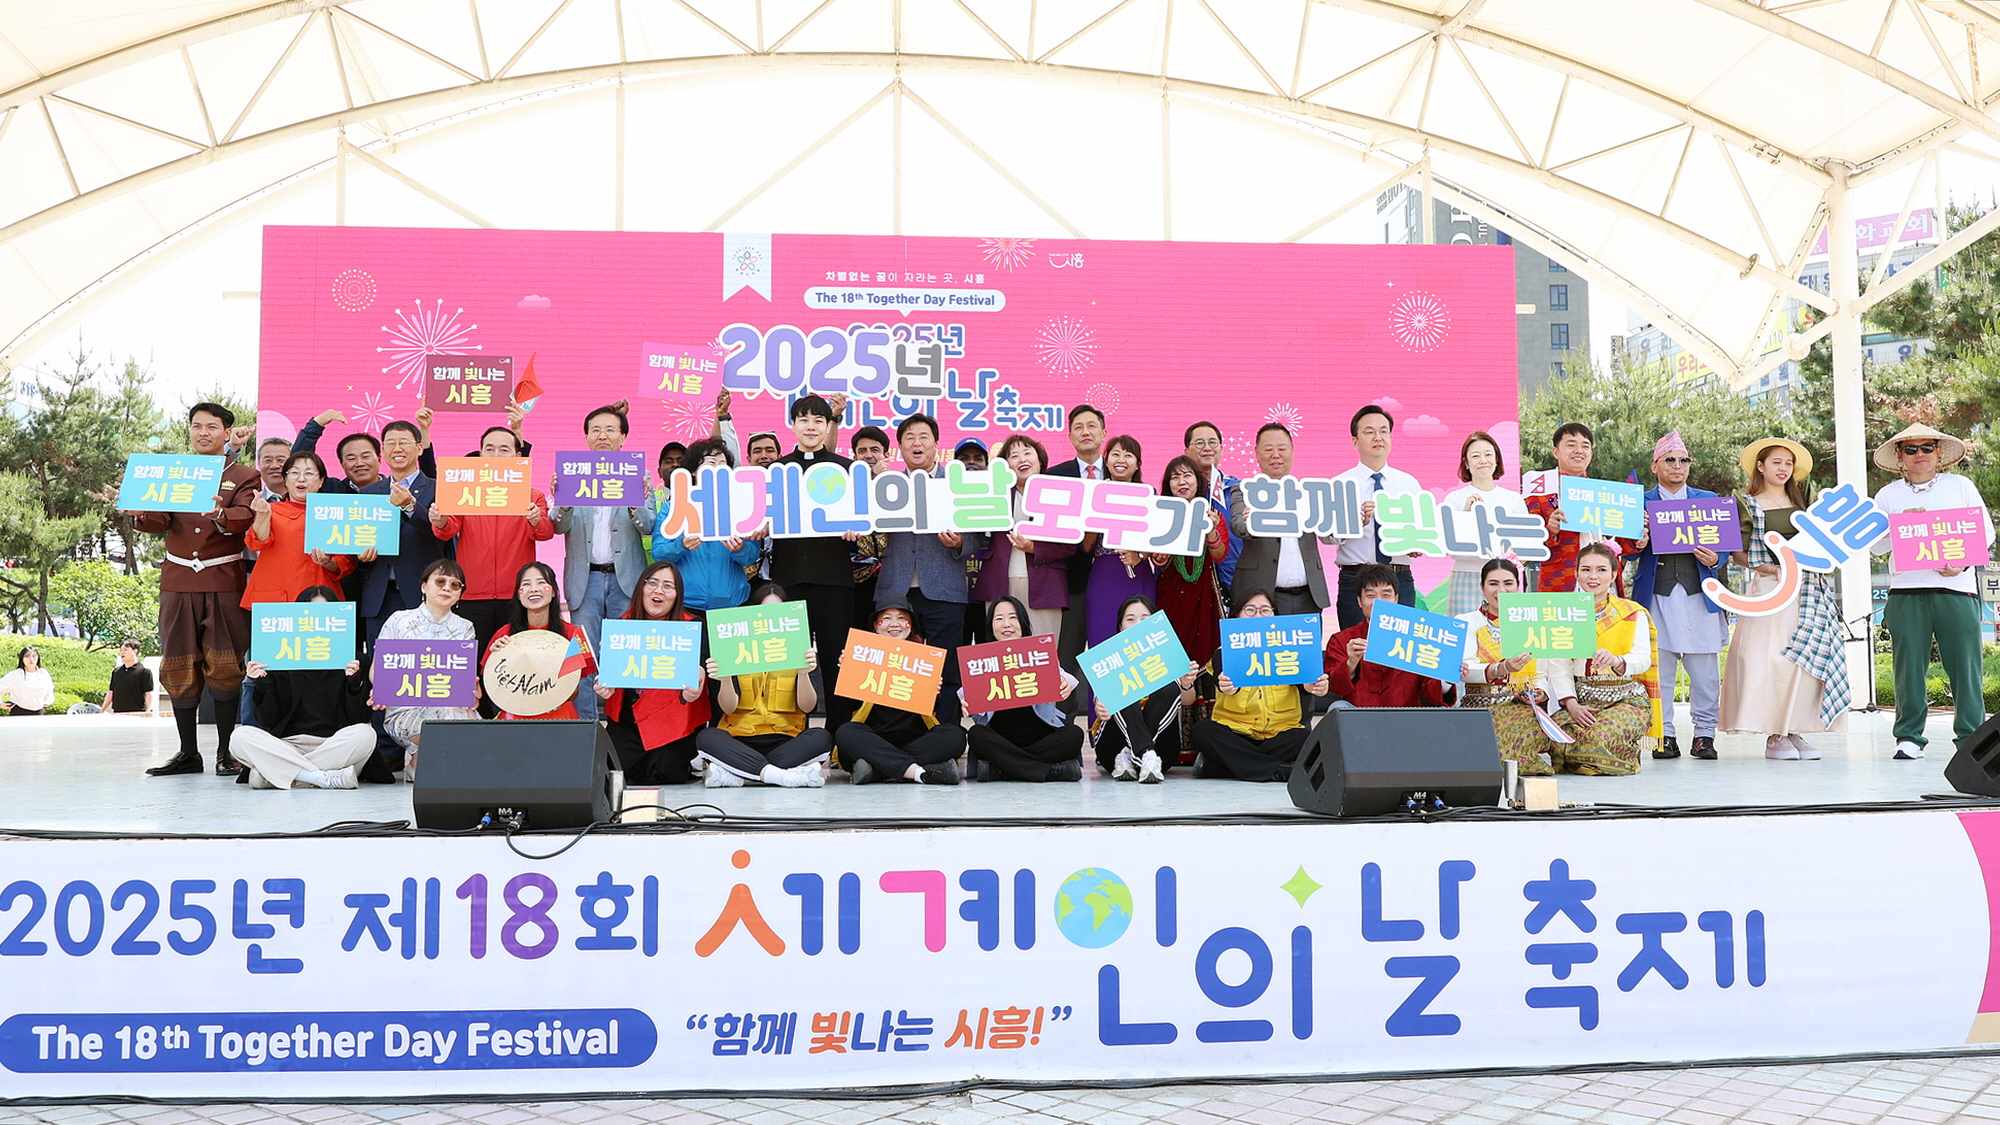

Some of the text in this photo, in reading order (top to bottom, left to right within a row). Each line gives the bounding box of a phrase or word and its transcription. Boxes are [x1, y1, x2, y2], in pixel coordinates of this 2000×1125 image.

[825, 271, 870, 282] 차별없는
[876, 272, 897, 283] 꿈이
[904, 273, 937, 284] 자라는
[964, 274, 985, 284] 시흥
[815, 292, 995, 306] The 18th Together Day Festival
[649, 354, 717, 372] 함께 빛나는
[721, 326, 942, 396] 2025년
[1677, 354, 1707, 379] 우리
[433, 367, 505, 381] 함께 빛나는
[658, 373, 704, 394] 시흥
[445, 384, 492, 404] 시흥
[997, 387, 1063, 428] 축제
[134, 466, 213, 480] 함께 빛나는
[445, 469, 523, 482] 함께 빛나는
[563, 462, 638, 475] 함께 빛나는
[141, 483, 195, 503] 시흥
[458, 486, 508, 506] 시흥
[574, 478, 624, 499] 시흥
[1568, 489, 1636, 507] 함께 빛나는
[314, 506, 392, 521] 함께 빛나는
[663, 467, 928, 535] 세계인의
[949, 460, 1013, 529] 날
[1018, 478, 1209, 551] 모두가
[1248, 478, 1359, 535] 함께
[1377, 496, 1548, 557] 빛나는
[1580, 507, 1624, 528] 시흥
[1655, 509, 1732, 523] 함께 빛나는
[326, 525, 377, 546] 시흥
[1672, 525, 1720, 545] 시흥
[1898, 517, 1976, 538] 함께 빛나는
[1916, 539, 1966, 561] 시흥
[261, 617, 347, 632] 함께 빛나는
[1507, 607, 1587, 621] 함께 빛나는
[716, 621, 749, 638] 함께
[753, 617, 800, 634] 빛나는
[1379, 614, 1458, 647] 함께 빛나는
[1524, 626, 1574, 649] 시흥
[276, 636, 331, 660] 시흥
[610, 634, 691, 650] 함께 빛나는
[1229, 629, 1314, 649] 함께 빛나는
[383, 653, 468, 669] 함께 빛나는
[735, 638, 787, 664] 시흥
[852, 645, 934, 677] 함께 빛나는
[1092, 631, 1169, 678] 함께 빛나는
[1388, 638, 1442, 669] 시흥
[622, 655, 676, 679] 시흥
[967, 650, 1050, 676] 함께 빛나는
[1245, 650, 1300, 677] 시흥
[860, 669, 914, 701] 시흥
[1119, 654, 1168, 695] 시흥
[395, 673, 452, 698] 시흥
[987, 672, 1039, 702] 시흥
[0, 877, 305, 974] 2025년
[341, 871, 659, 961] 제18회
[1360, 860, 1476, 1038] 날
[1523, 858, 1767, 1032] 축제
[809, 1009, 934, 1053] 빛나는
[32, 1019, 619, 1066] The 18th Together Day Festival
